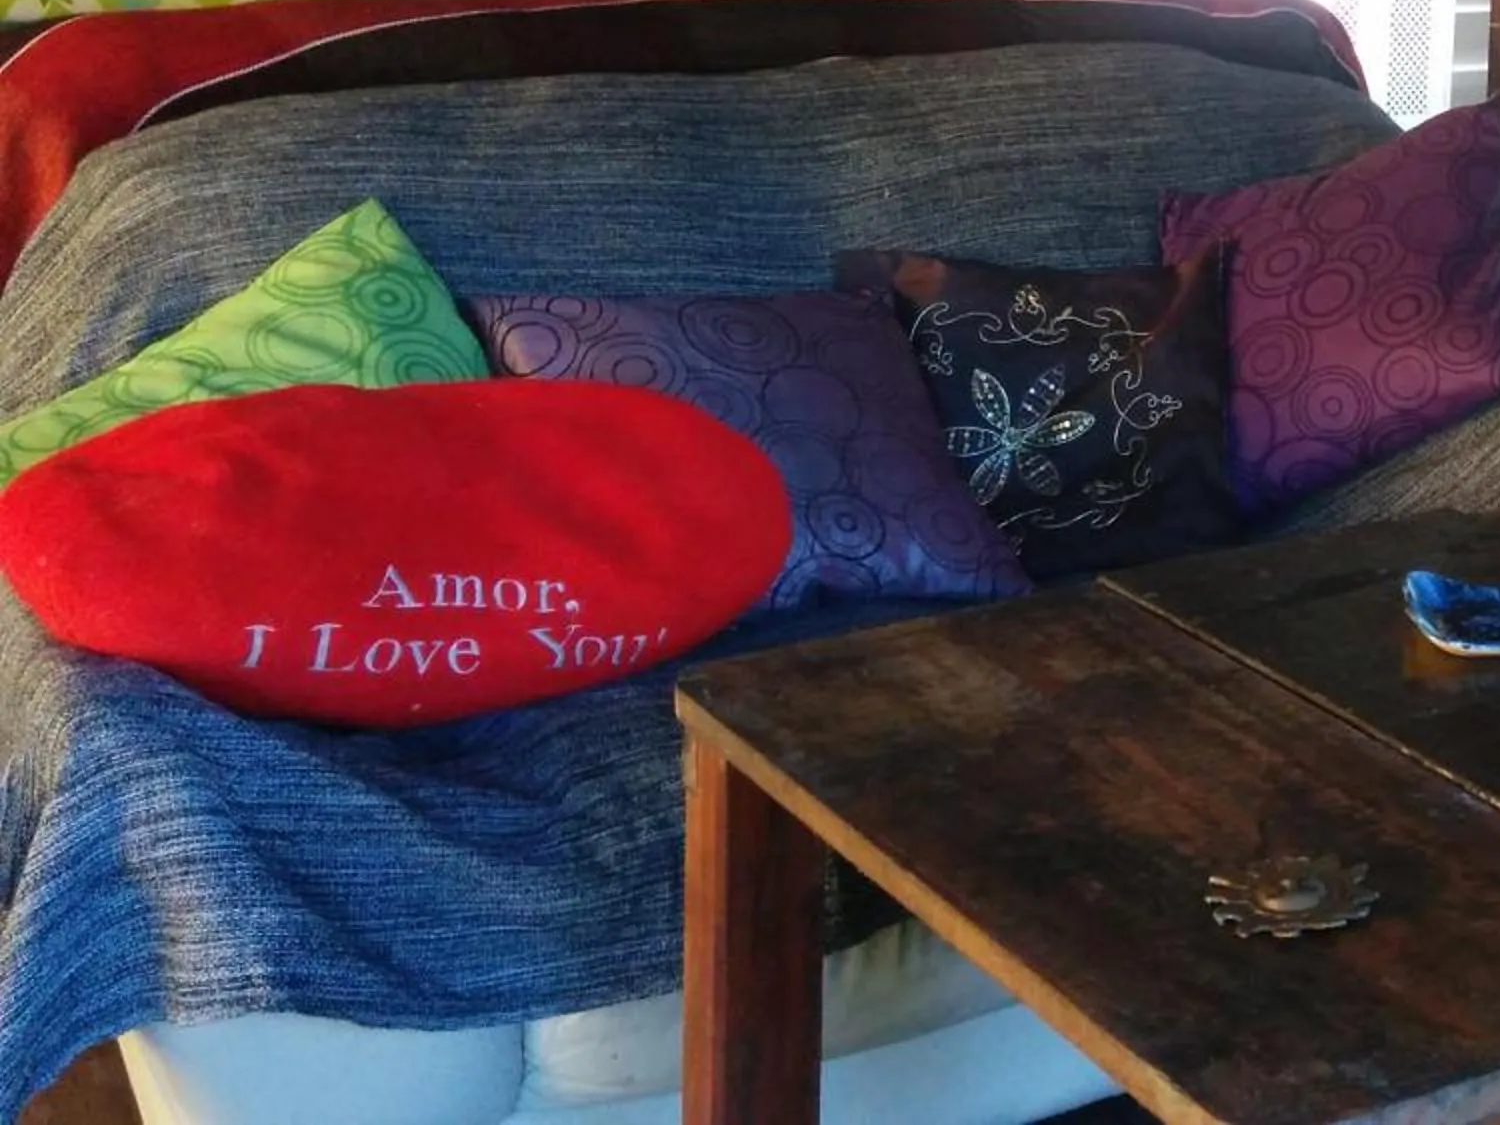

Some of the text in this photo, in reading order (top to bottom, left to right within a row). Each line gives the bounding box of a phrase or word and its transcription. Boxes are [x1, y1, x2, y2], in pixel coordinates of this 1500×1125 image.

[361, 563, 581, 615] Amor,
[242, 623, 277, 669] I
[308, 622, 481, 675] Love
